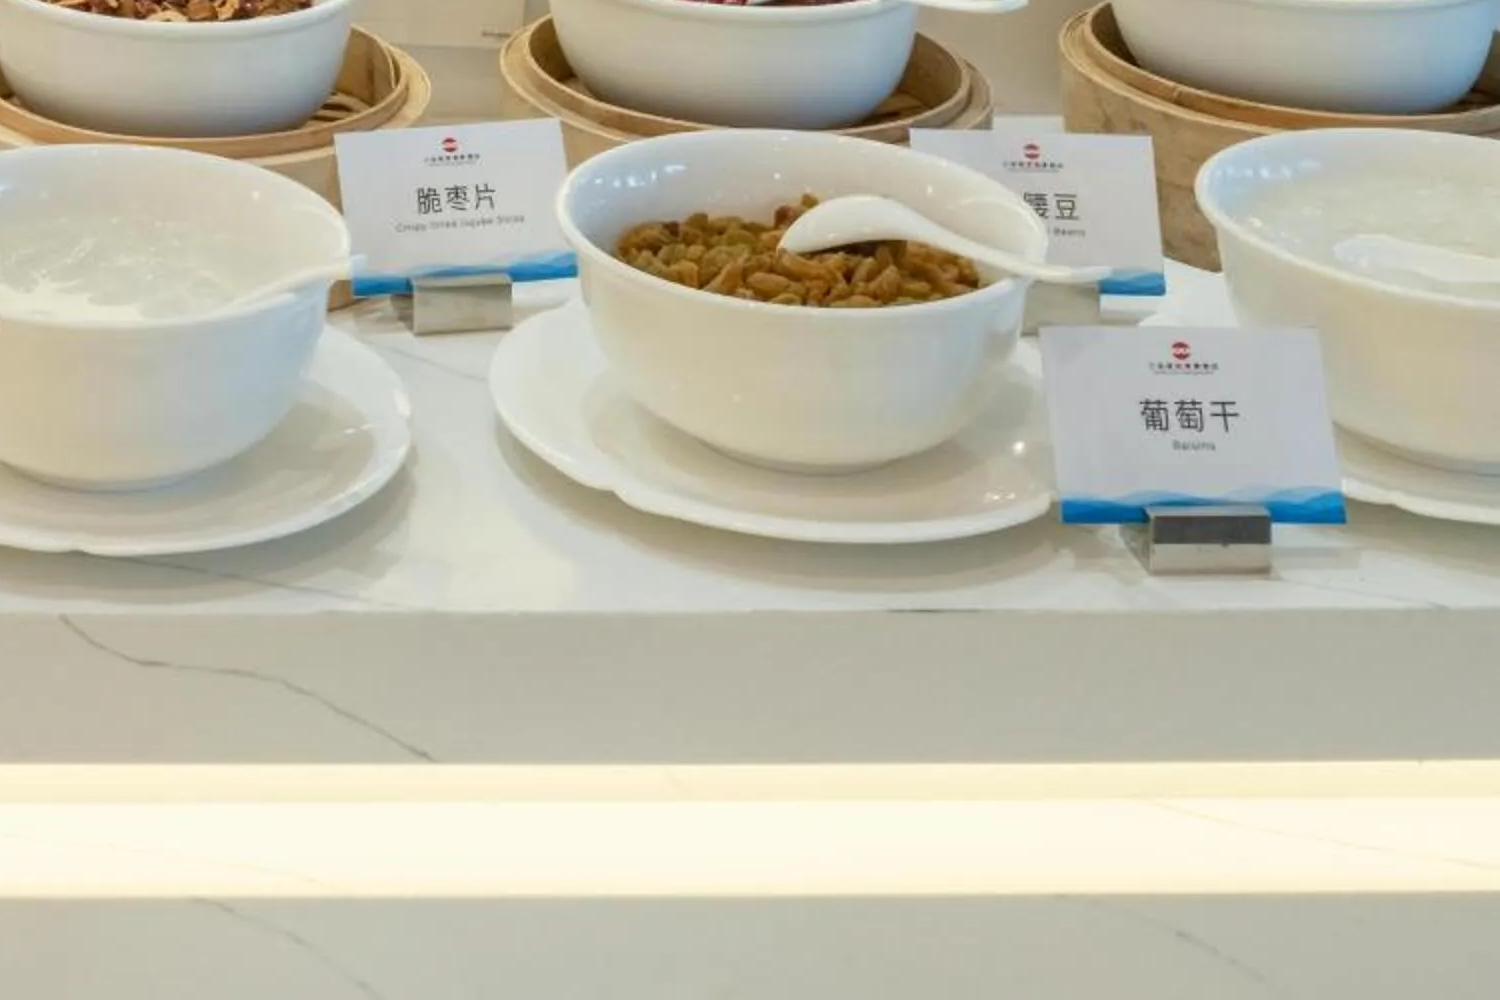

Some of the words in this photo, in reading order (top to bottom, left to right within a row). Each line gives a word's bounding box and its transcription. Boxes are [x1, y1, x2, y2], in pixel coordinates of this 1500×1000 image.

[416, 183, 496, 214] 脆枣片
[1139, 398, 1239, 433] 葡萄干
